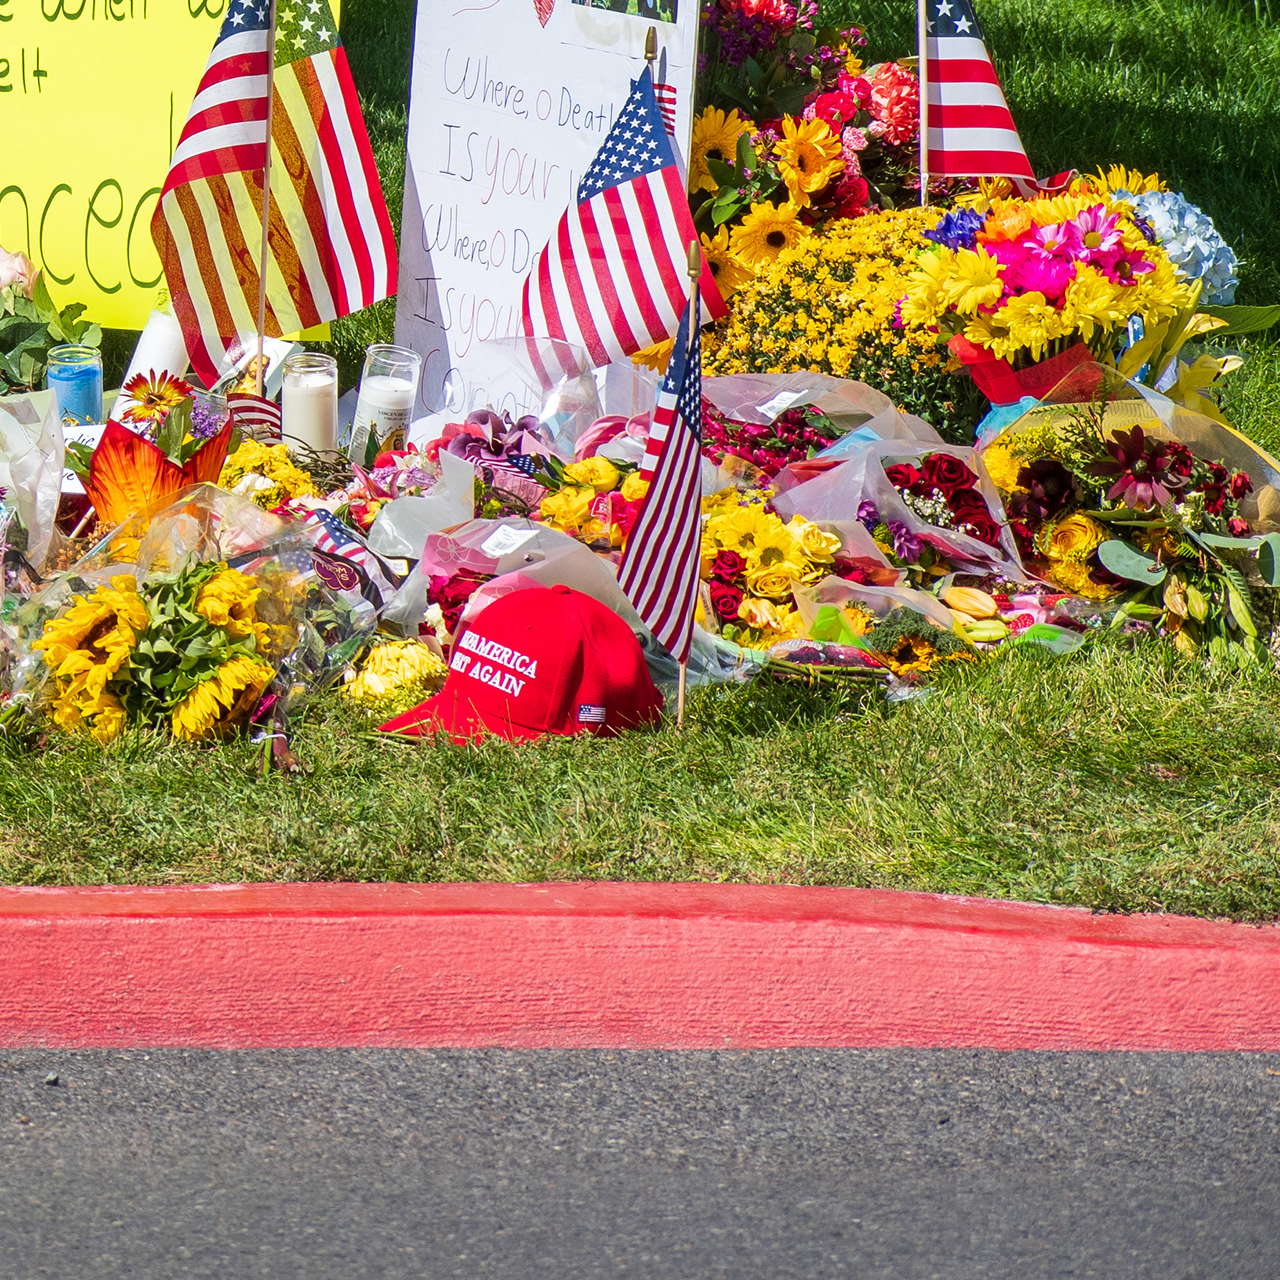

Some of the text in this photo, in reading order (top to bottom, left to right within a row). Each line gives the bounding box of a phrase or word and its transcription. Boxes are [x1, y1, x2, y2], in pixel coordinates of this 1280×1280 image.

[443, 47, 529, 120] Where,
[535, 88, 553, 121] O
[480, 135, 560, 205] your
[420, 203, 490, 271] Where,
[468, 661, 527, 698] AGAIN
[470, 634, 538, 679] AMERICA
